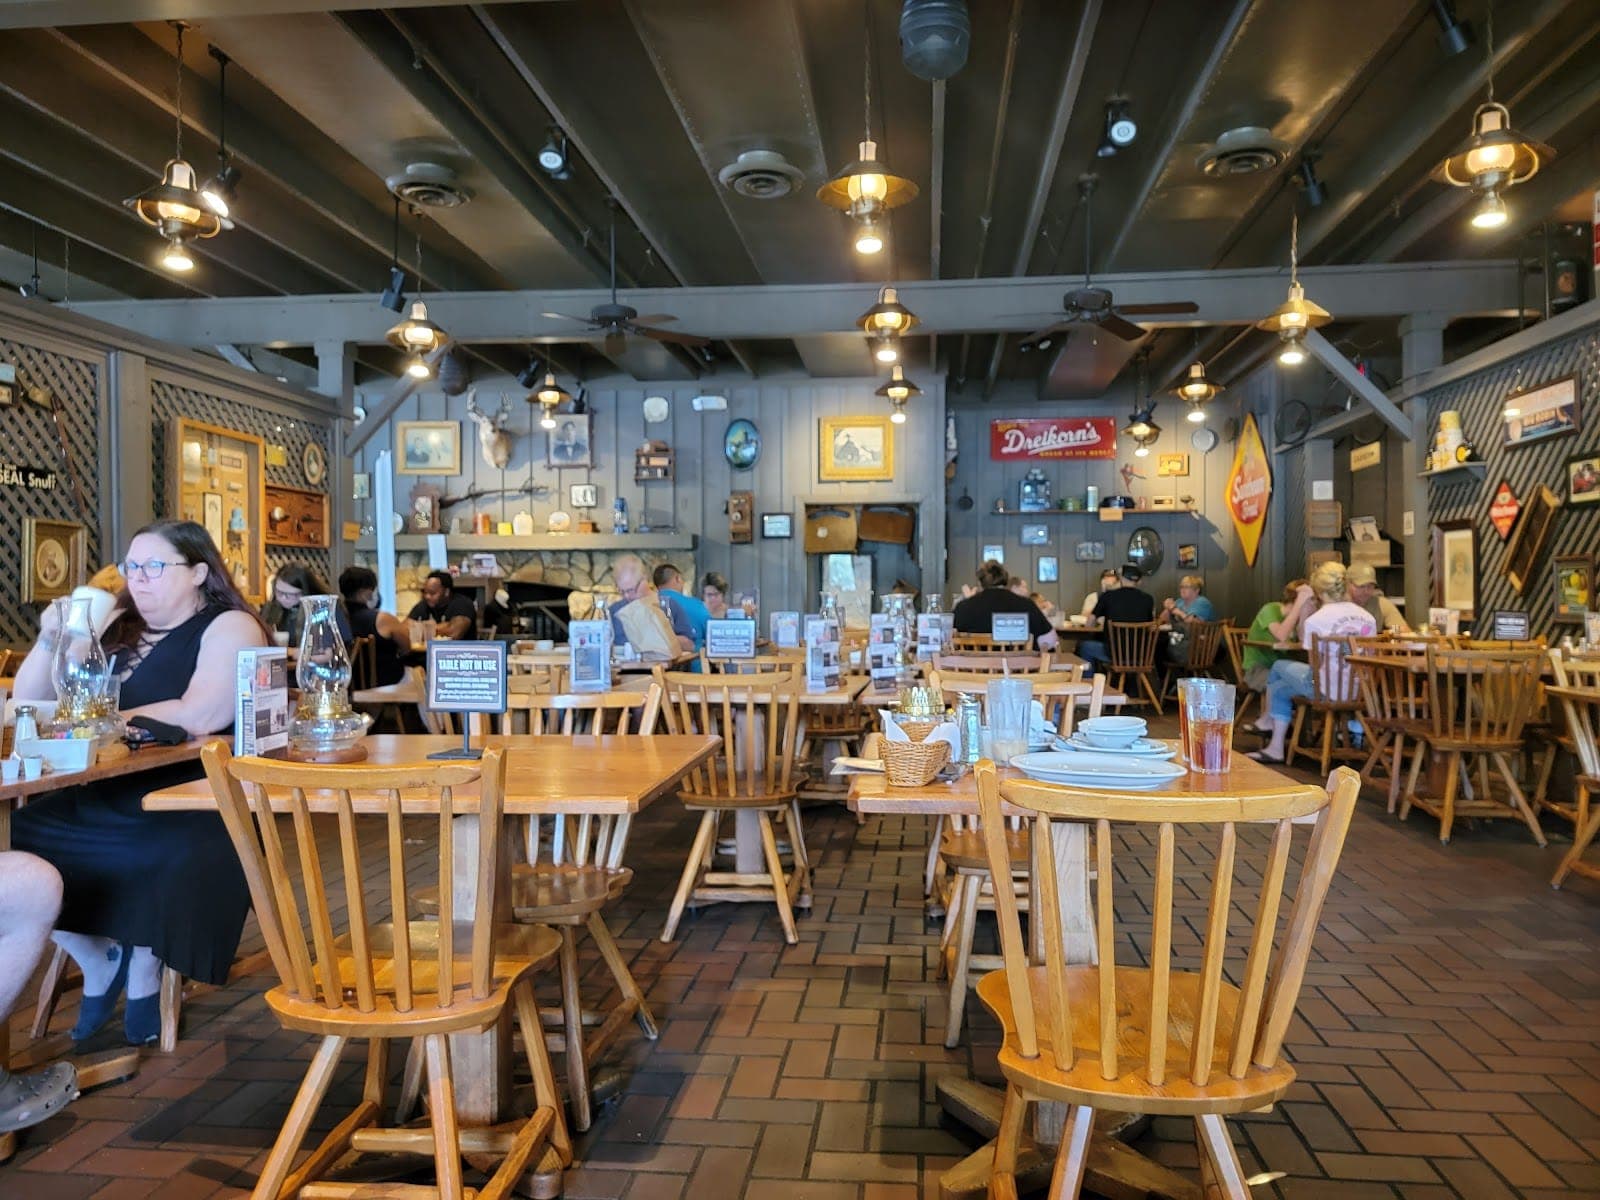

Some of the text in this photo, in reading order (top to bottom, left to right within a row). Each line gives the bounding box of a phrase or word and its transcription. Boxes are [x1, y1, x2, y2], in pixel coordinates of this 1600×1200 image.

[1001, 421, 1102, 454] Dreikorn's
[28, 471, 57, 490] Snuff
[438, 659, 497, 671] TABLE NOT IN USE
